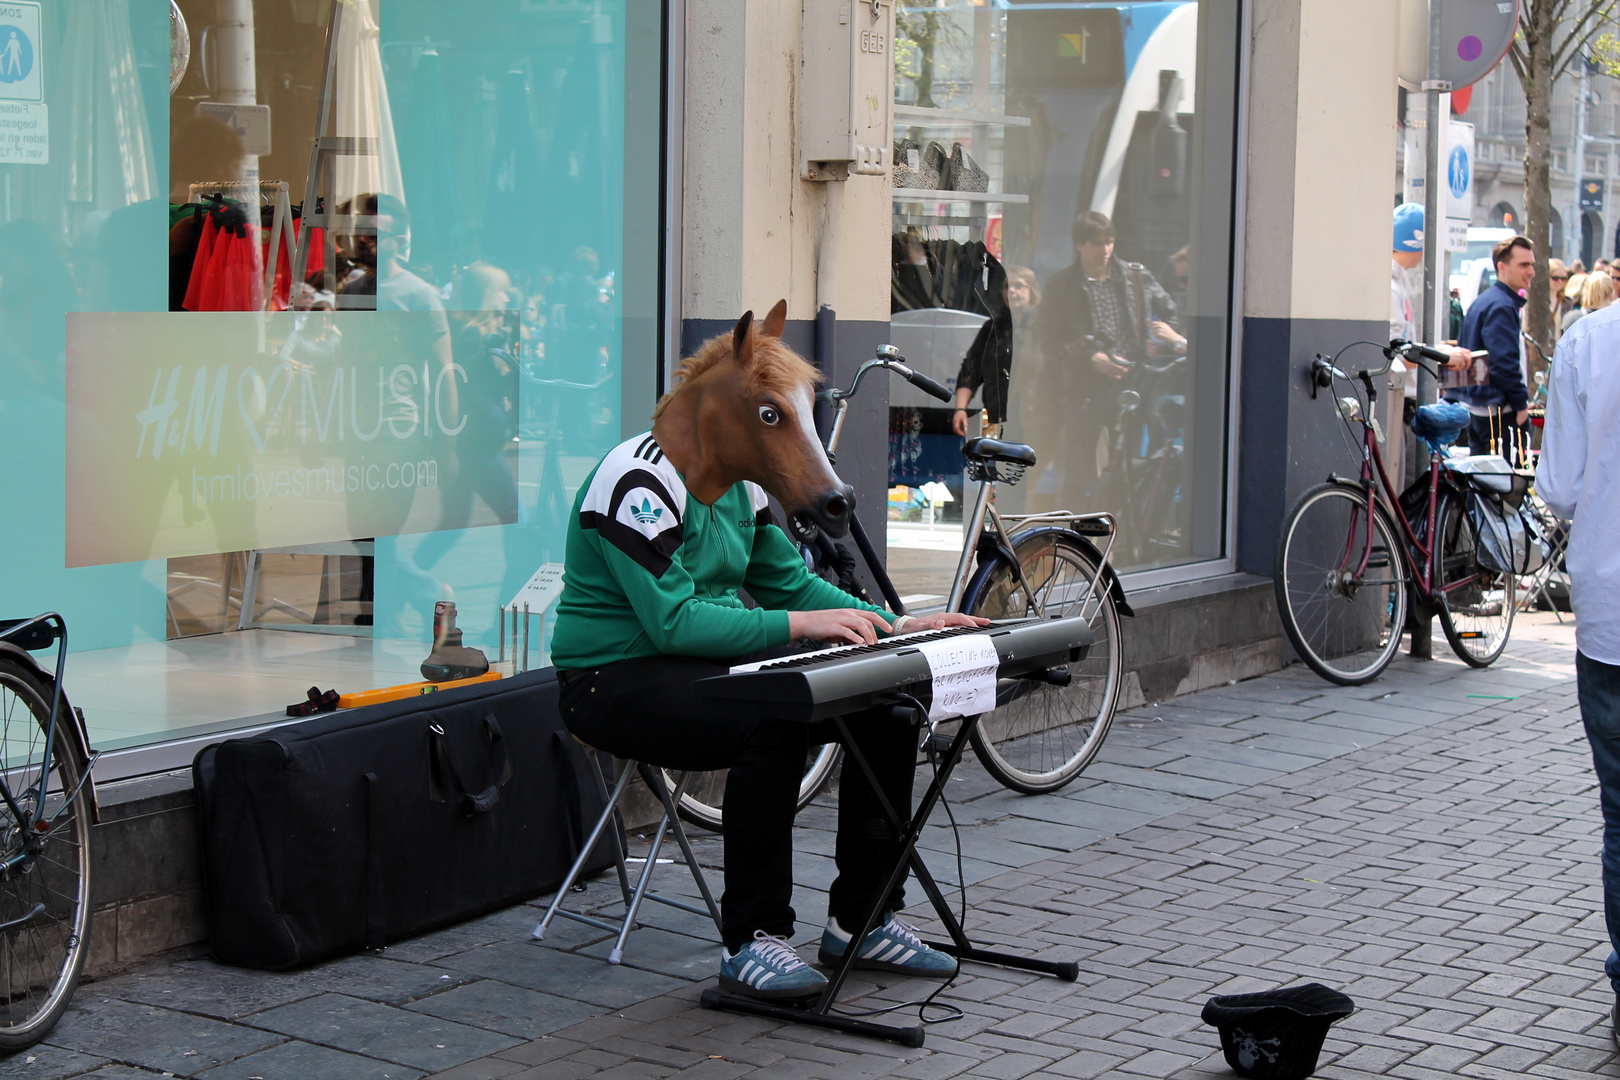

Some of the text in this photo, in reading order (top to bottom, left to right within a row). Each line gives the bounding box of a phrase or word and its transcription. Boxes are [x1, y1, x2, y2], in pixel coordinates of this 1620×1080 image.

[860, 30, 884, 54] GEB
[135, 363, 469, 462] H&M MUSIC
[192, 455, 438, 504] hmlovesmusic.com
[931, 650, 978, 671] COLLECTING
